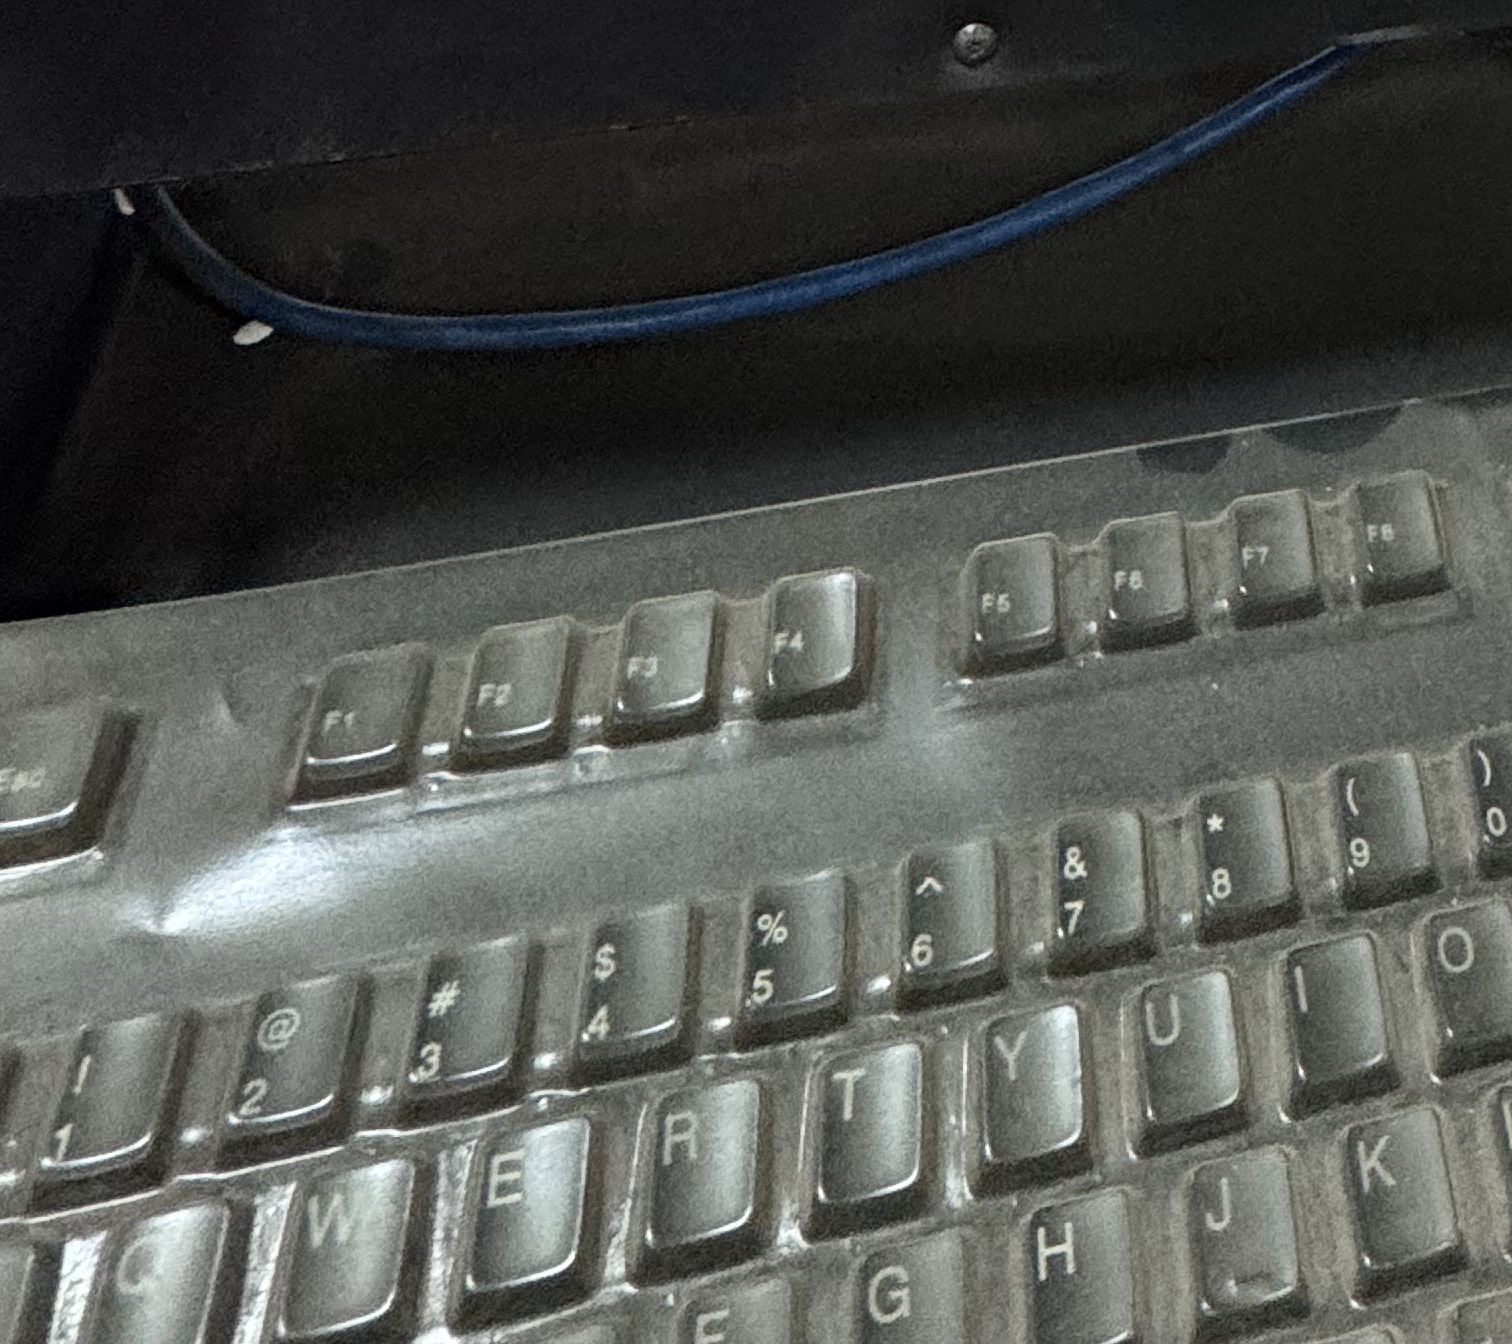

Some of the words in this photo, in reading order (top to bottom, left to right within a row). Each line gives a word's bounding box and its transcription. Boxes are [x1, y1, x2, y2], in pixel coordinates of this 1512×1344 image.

[1241, 545, 1269, 569] F7
[774, 631, 805, 655] F4
[1350, 837, 1371, 869] 9
[1210, 868, 1233, 900] 8
[258, 1007, 301, 1053] @
[1144, 994, 1182, 1047] U
[994, 1031, 1029, 1081] Y
[833, 1068, 865, 1121] T
[487, 1150, 525, 1208] E
[1357, 1135, 1397, 1193] K
[1204, 1176, 1232, 1232] J
[1036, 1220, 1077, 1282] H
[868, 1264, 911, 1324] G
